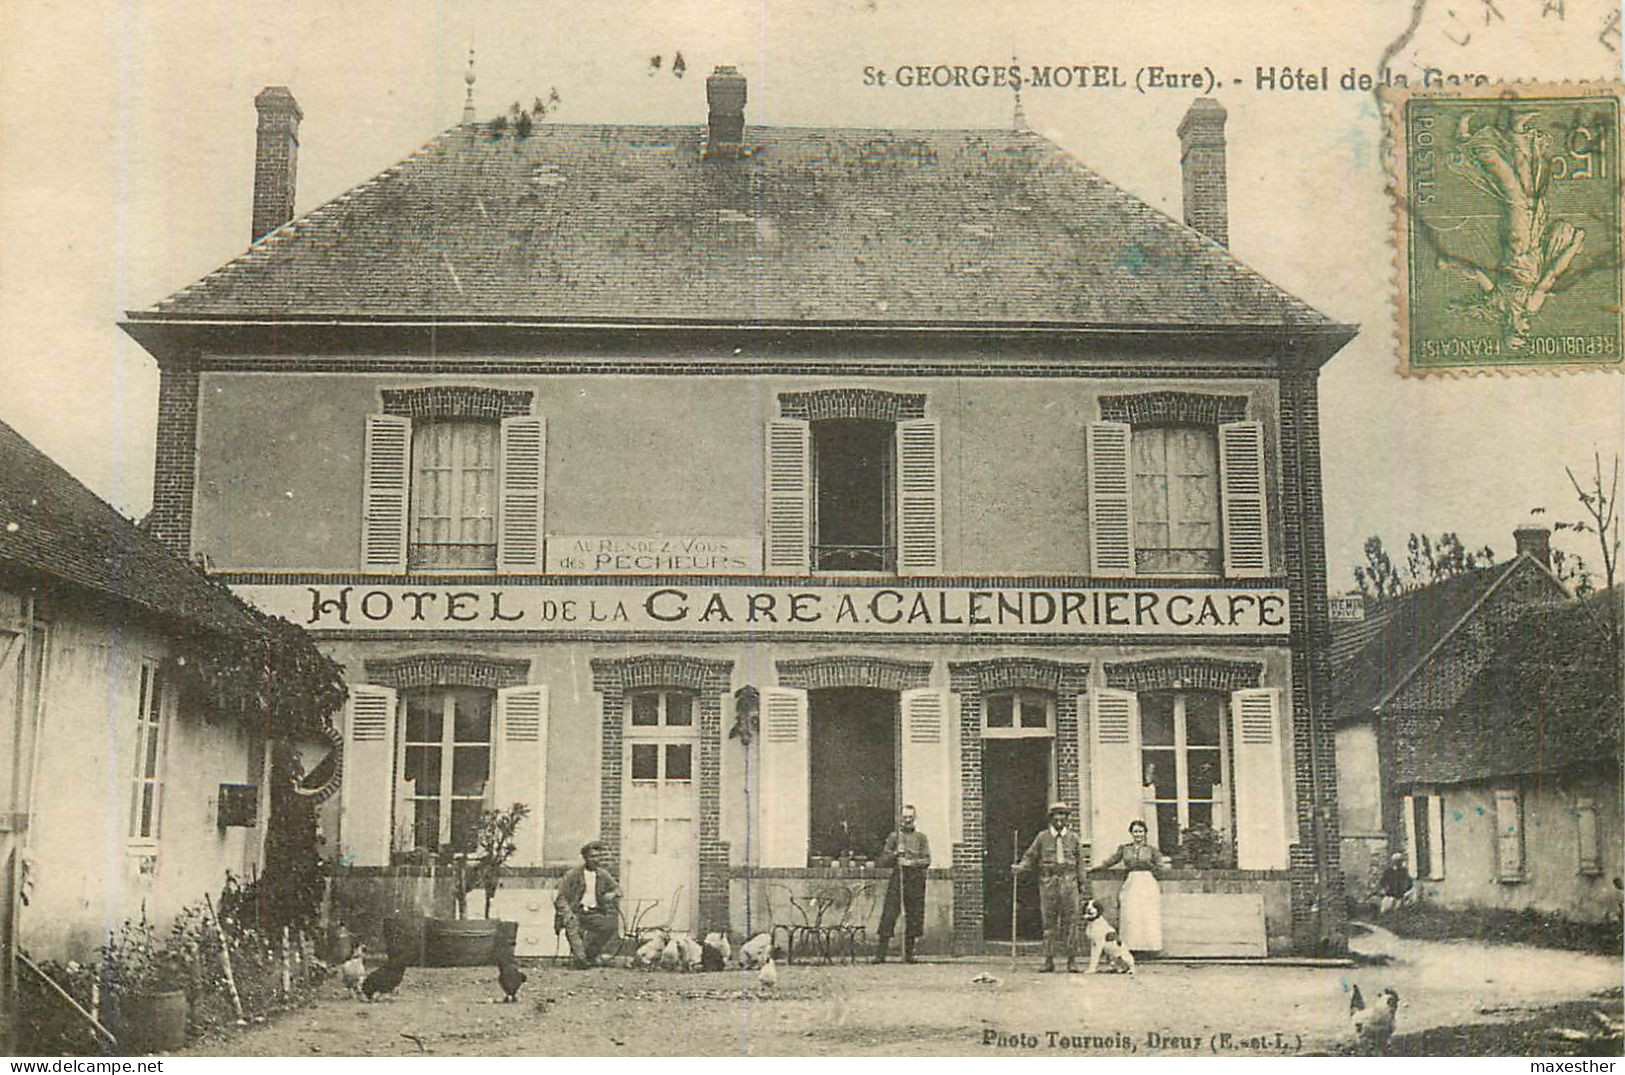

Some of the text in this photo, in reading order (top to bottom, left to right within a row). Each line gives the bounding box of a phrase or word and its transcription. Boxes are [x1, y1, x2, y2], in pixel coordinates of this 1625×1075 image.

[560, 556, 585, 569] des
[307, 586, 524, 625] HOTEL
[541, 600, 577, 622] DE
[589, 600, 630, 622] LA
[642, 588, 822, 624] GARE
[1165, 594, 1285, 626] CAFE
